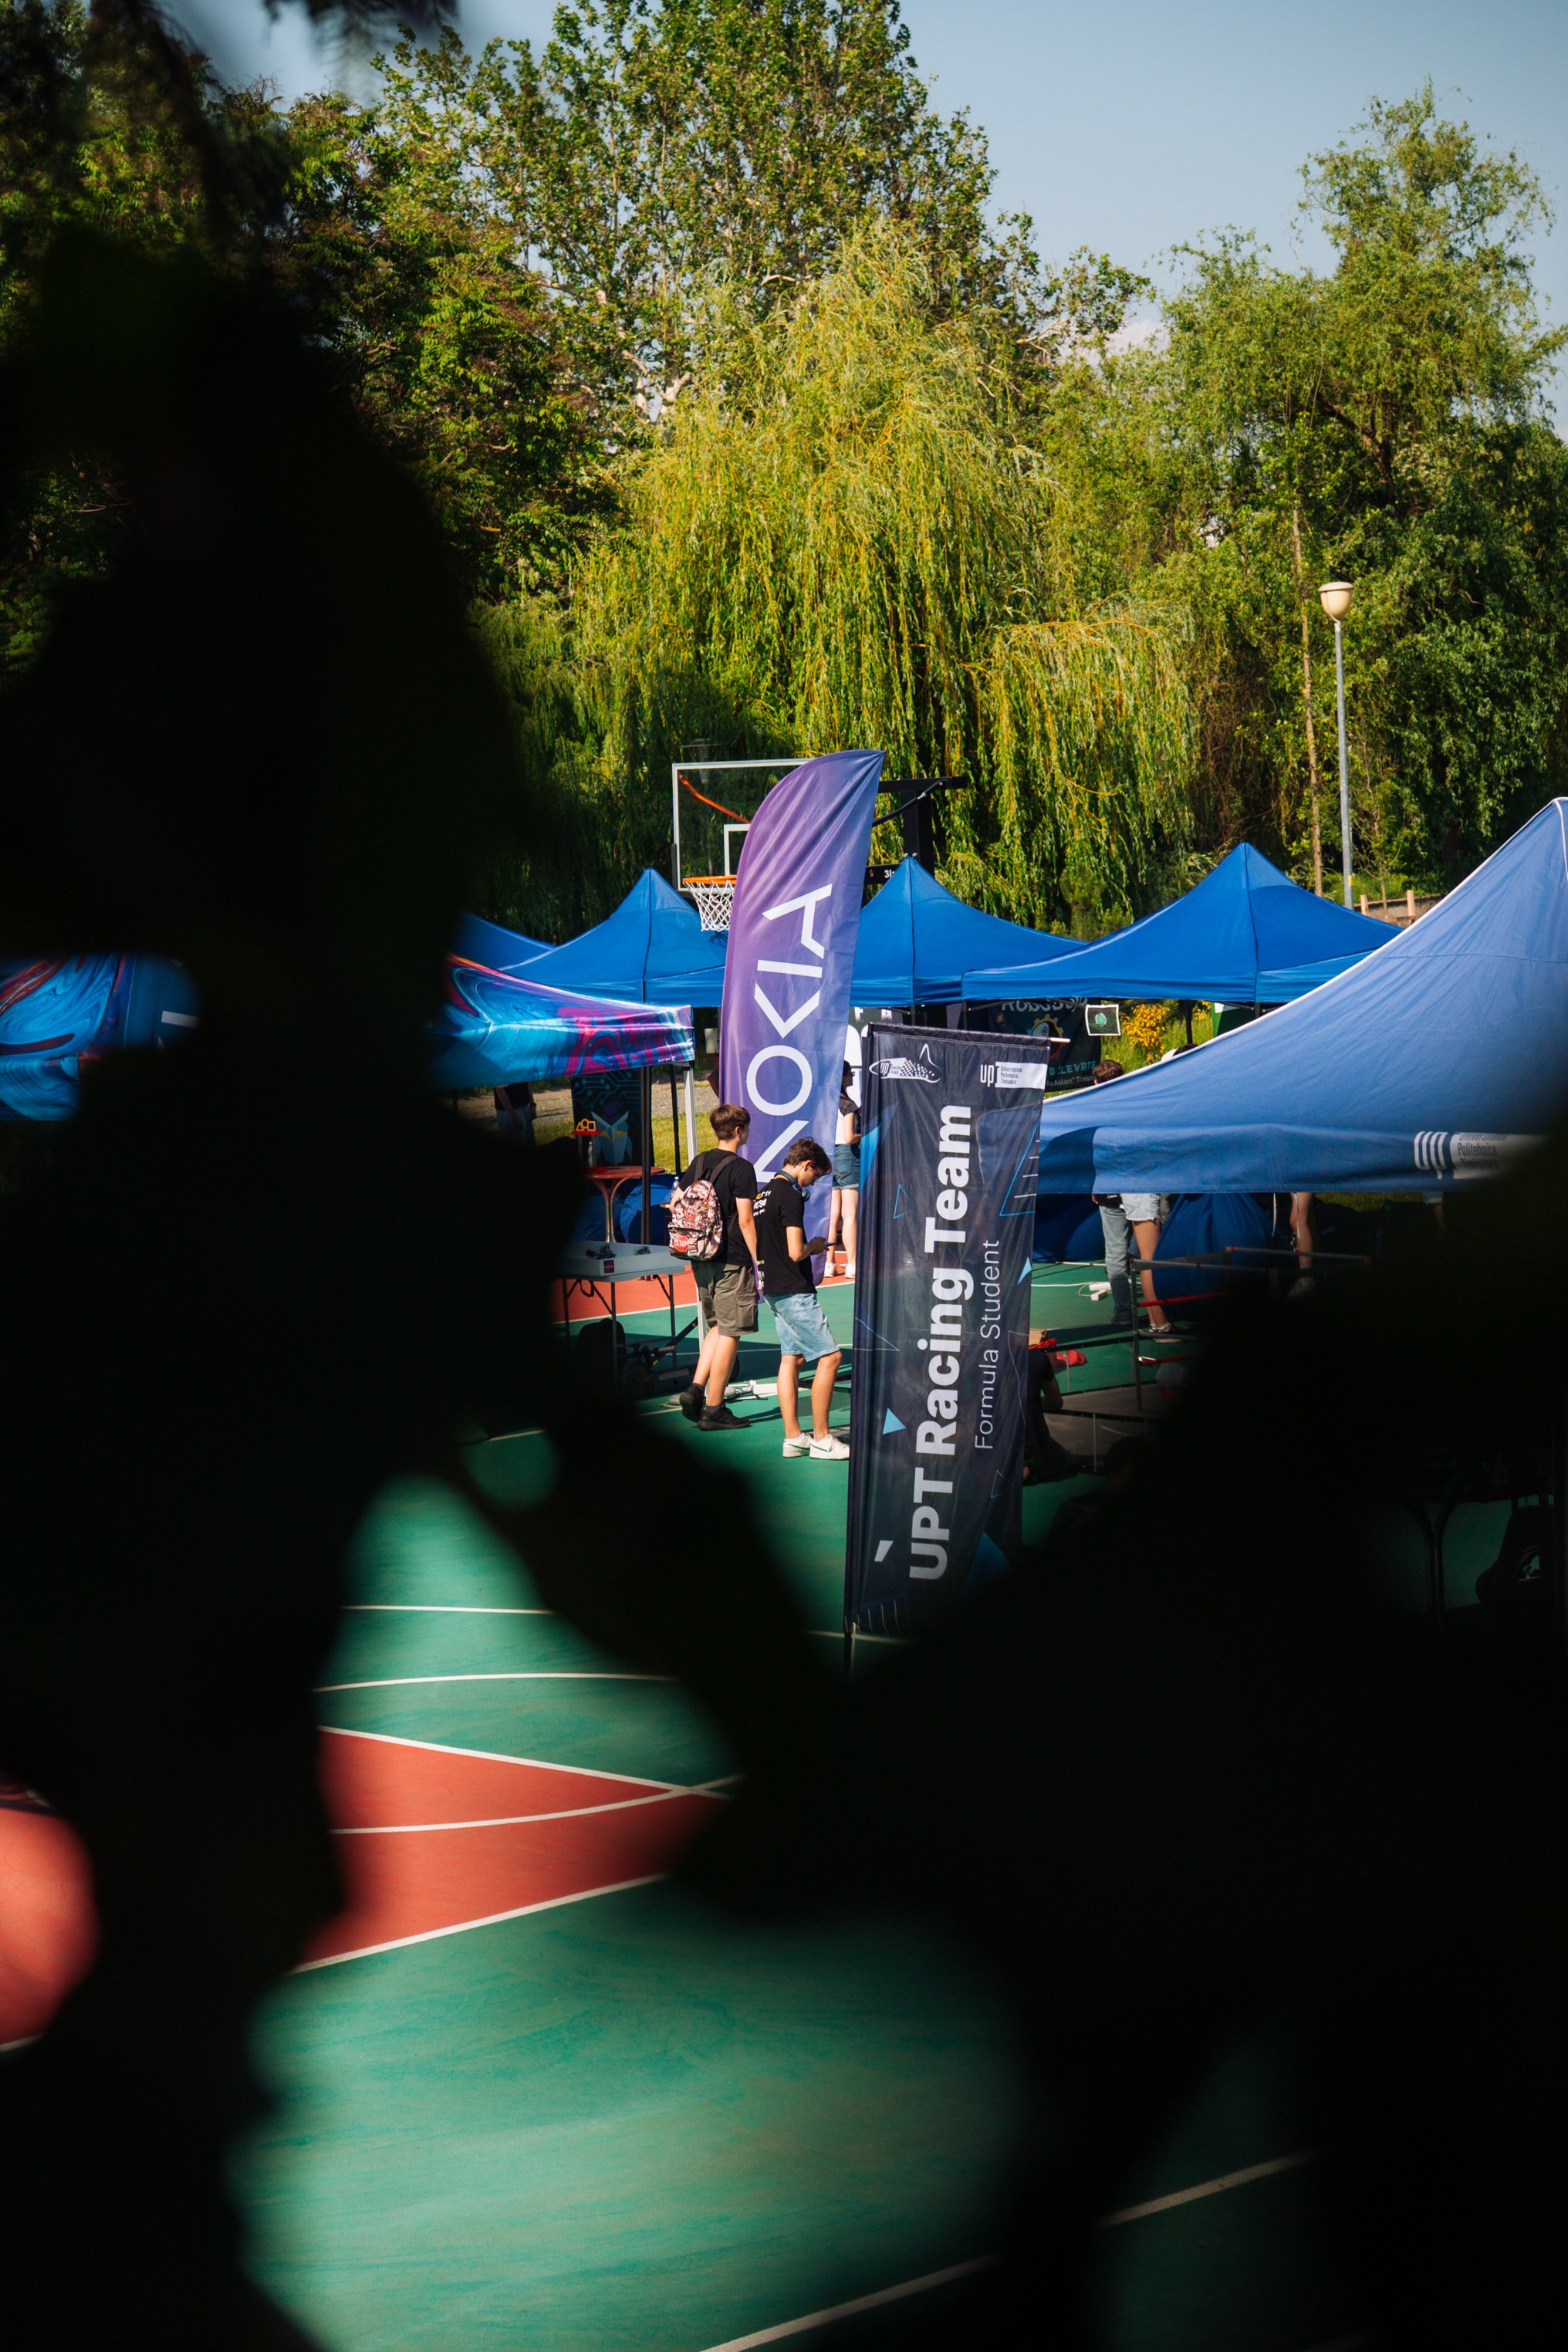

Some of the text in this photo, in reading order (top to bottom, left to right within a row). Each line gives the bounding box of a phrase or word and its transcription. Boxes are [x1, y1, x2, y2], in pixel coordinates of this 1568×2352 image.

[746, 883, 833, 1183] NOKIA
[1457, 1142, 1498, 1157] Politehnica
[909, 1105, 974, 1580] UPT Racing Team
[975, 1240, 1001, 1449] Formula Student
